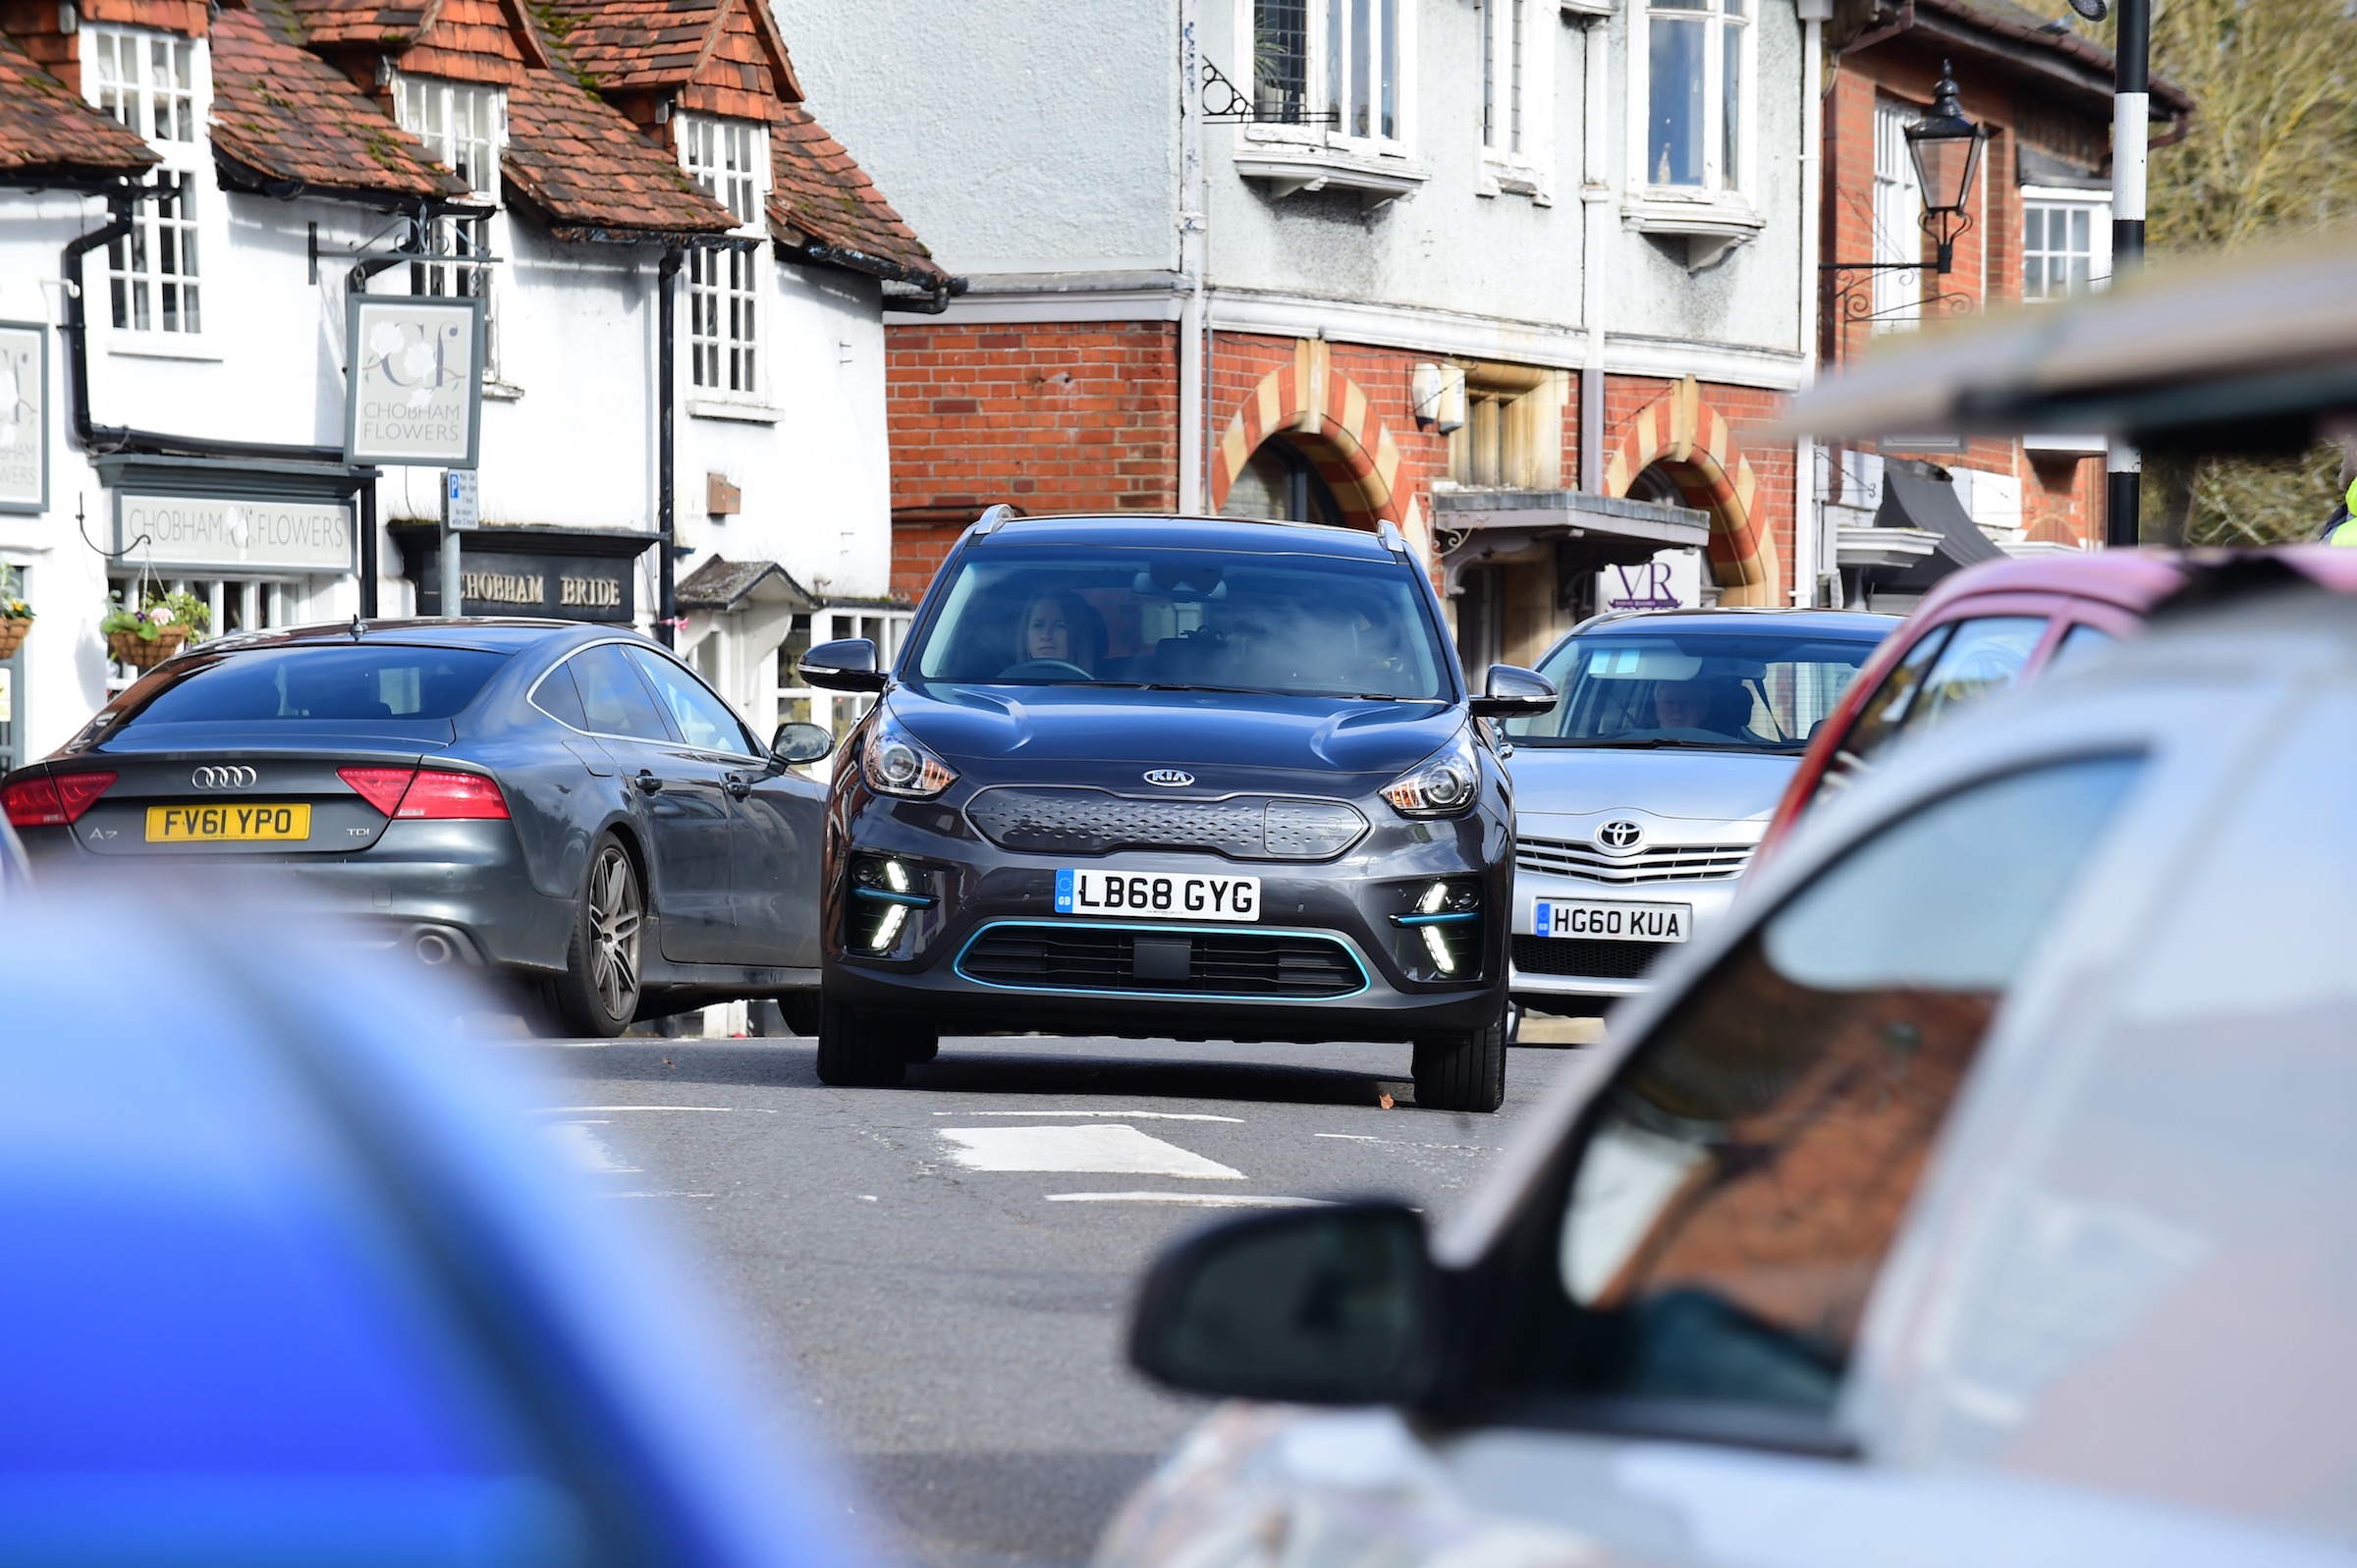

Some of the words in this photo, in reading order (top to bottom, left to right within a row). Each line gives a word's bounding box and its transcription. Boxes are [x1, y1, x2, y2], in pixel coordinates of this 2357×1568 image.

[363, 402, 461, 421] CHOBHAM
[363, 422, 460, 442] FLOWERS
[129, 509, 224, 543] CHOBHAM
[257, 514, 344, 549] FLOWERS
[560, 576, 621, 606] BRIDE
[1152, 771, 1187, 782] KIA
[164, 809, 227, 836] FV61
[238, 808, 292, 834] YPO
[88, 827, 118, 840] A7
[346, 828, 370, 837] TDI
[1058, 895, 1071, 906] GB
[1080, 875, 1173, 910] LB68
[1184, 880, 1253, 913] GYG
[1555, 908, 1621, 934] HG60
[1630, 911, 1680, 937] KUA
